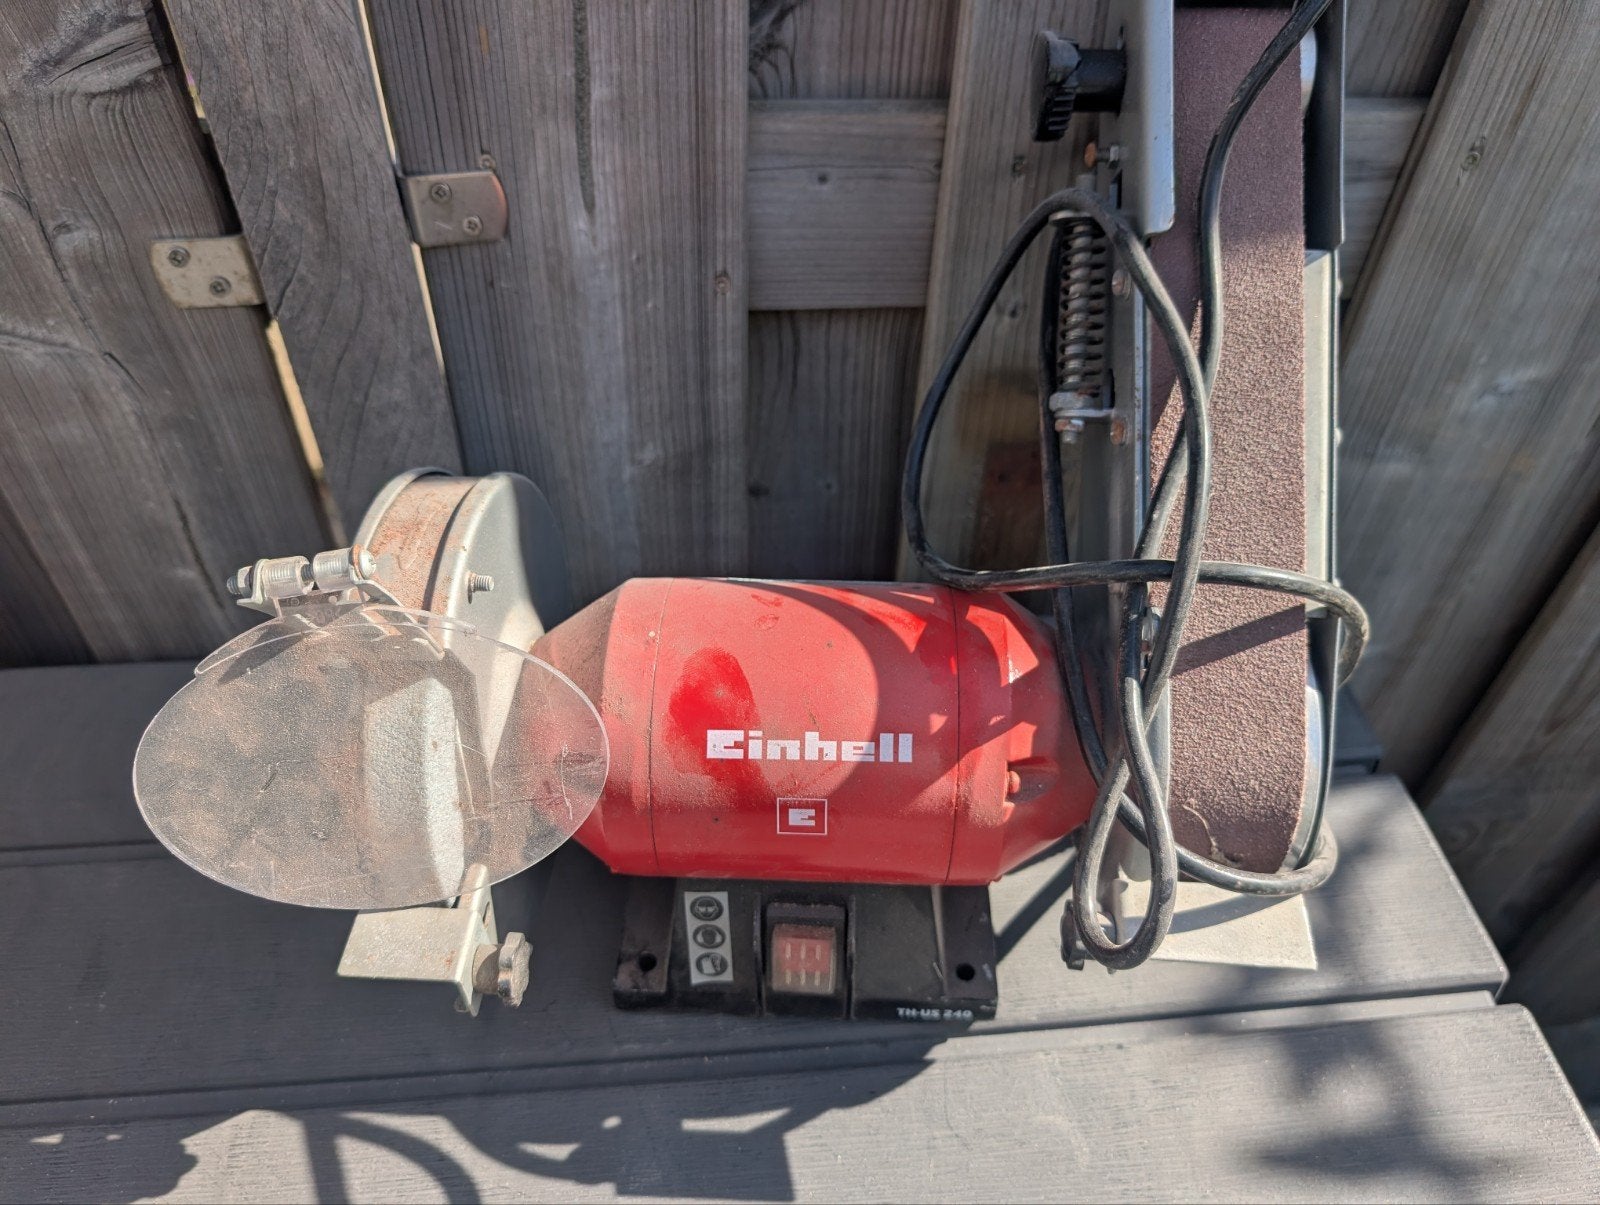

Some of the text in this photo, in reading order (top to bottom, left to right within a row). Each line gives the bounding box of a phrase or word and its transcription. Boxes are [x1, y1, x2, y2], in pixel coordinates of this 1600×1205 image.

[706, 729, 913, 763] Einhell
[788, 808, 816, 827] E
[897, 1007, 973, 1020] TH-US 240
